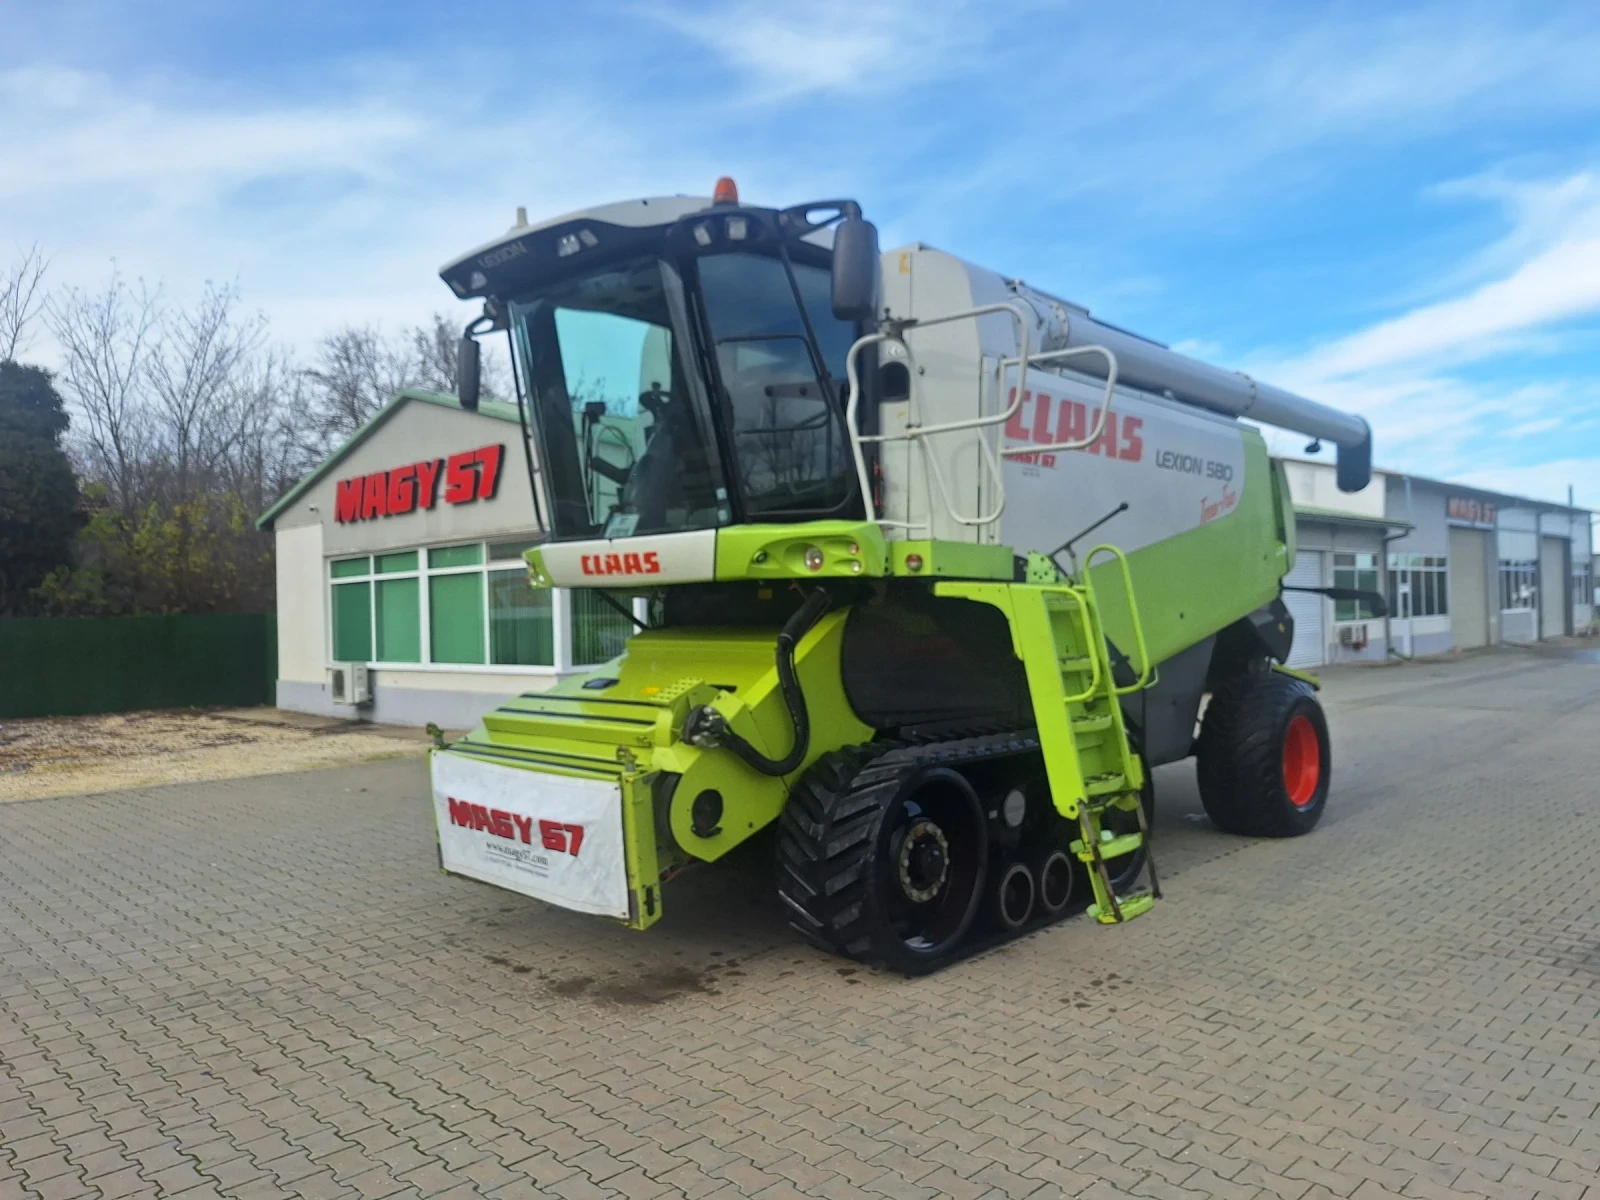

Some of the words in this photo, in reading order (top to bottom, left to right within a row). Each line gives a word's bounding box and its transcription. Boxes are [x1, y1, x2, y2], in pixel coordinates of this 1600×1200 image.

[1004, 387, 1144, 463] CLAAS
[334, 458, 445, 525] MAGY
[445, 444, 505, 506] 57
[1156, 449, 1203, 476] LEXION
[1206, 461, 1234, 483] 580
[581, 551, 661, 576] CLAAS
[447, 796, 533, 845] MAGY
[539, 819, 585, 857] 57
